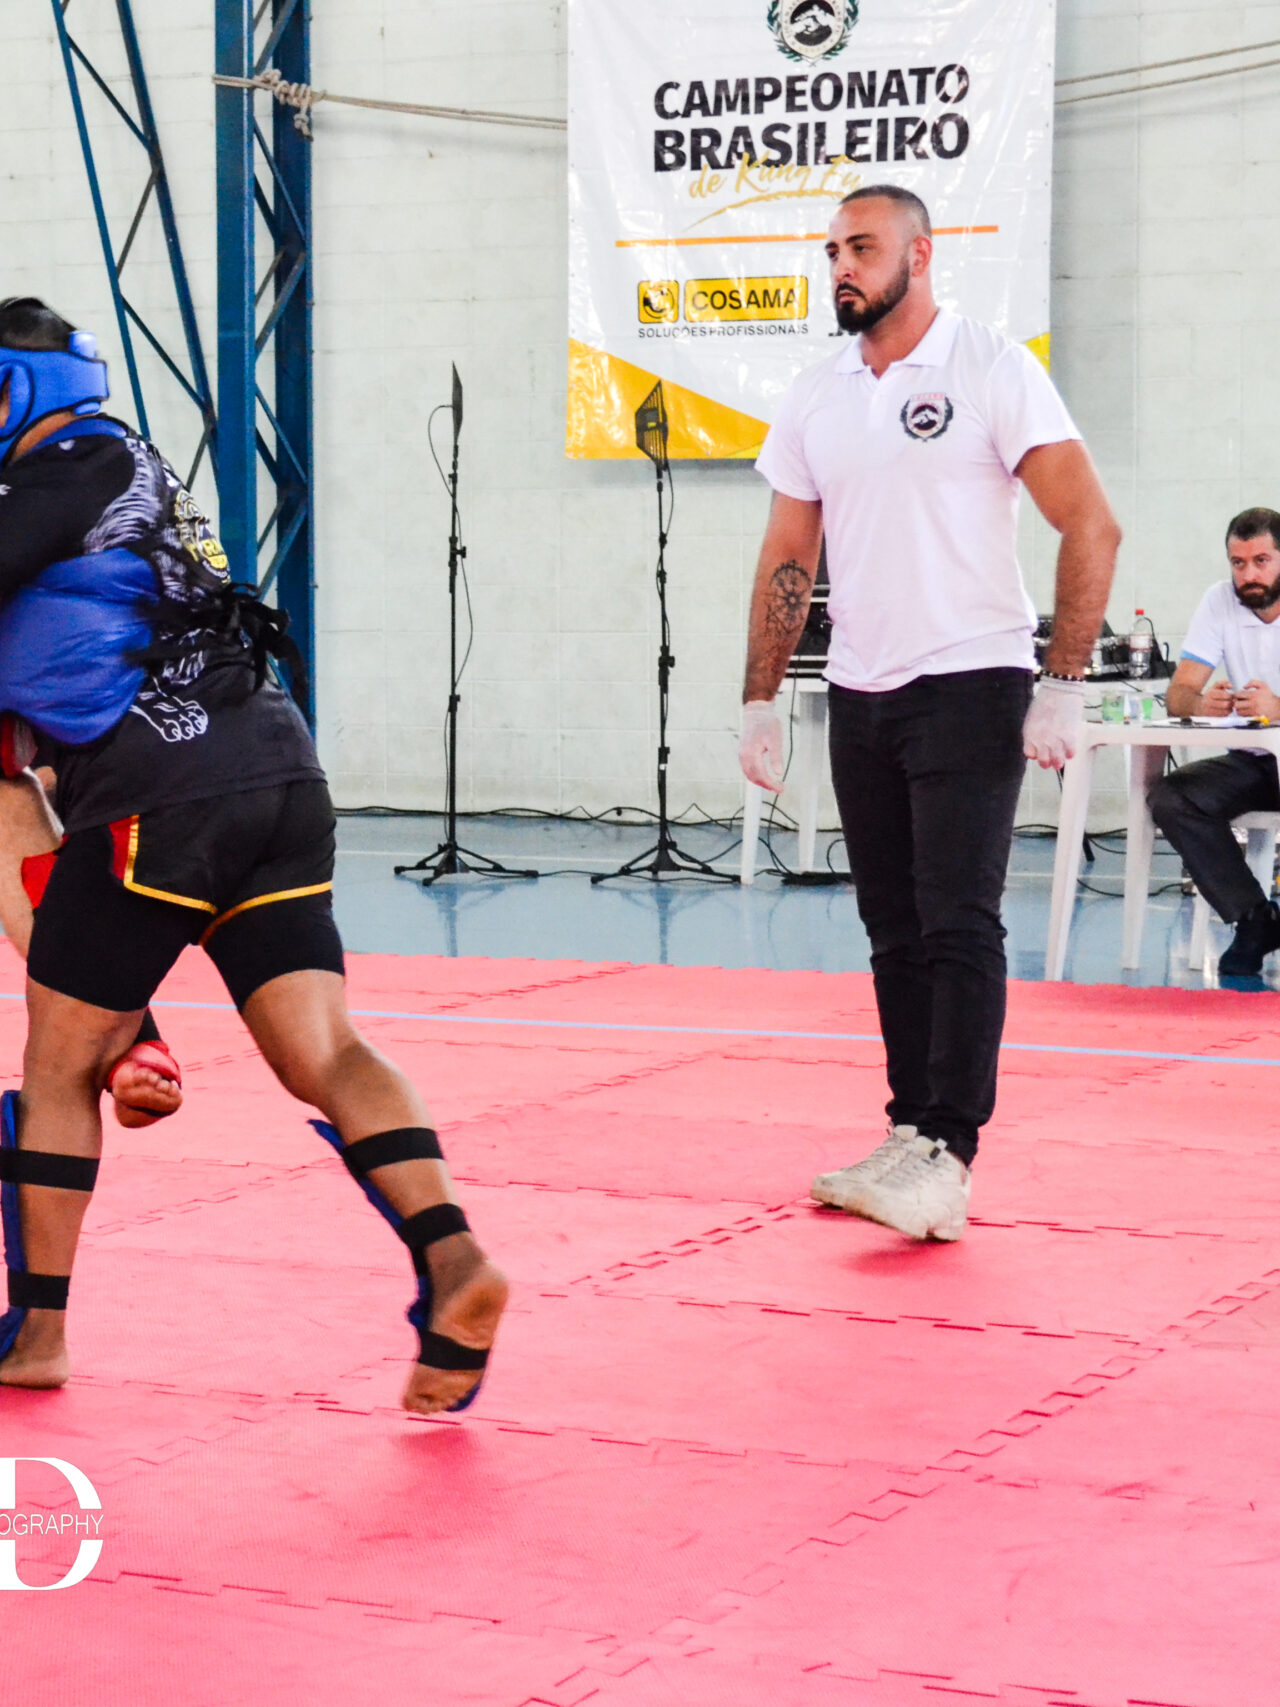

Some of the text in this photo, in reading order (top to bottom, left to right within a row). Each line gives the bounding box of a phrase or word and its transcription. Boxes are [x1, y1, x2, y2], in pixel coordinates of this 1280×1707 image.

[653, 64, 970, 120] CAMPEONATO
[653, 112, 970, 172] BRASILEIRO
[689, 151, 863, 198] de Kung Fu
[691, 288, 799, 311] COSAMA
